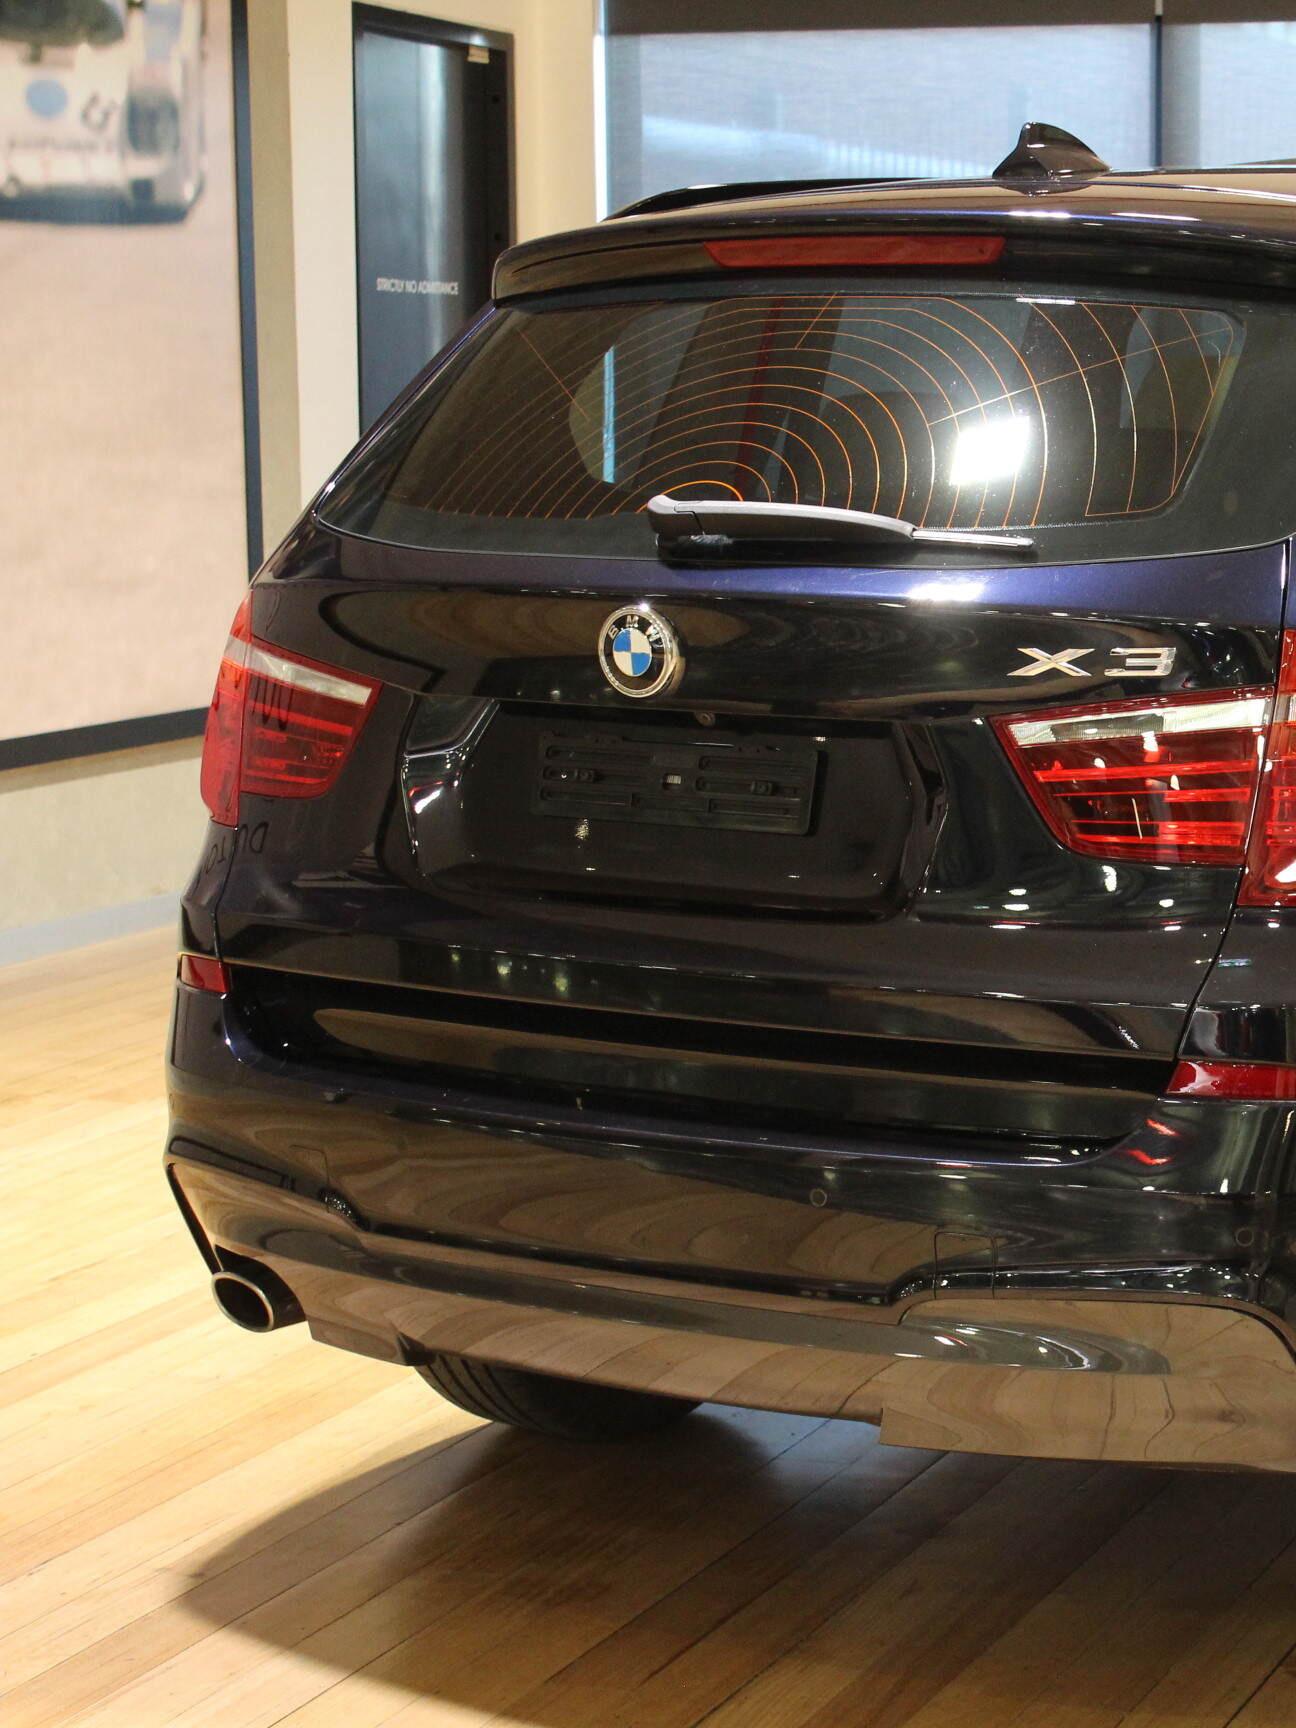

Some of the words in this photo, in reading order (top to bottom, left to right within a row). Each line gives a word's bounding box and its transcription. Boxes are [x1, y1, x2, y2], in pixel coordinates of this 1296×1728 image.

[376, 278, 405, 292] STRICTLY
[405, 280, 418, 294] NO
[1006, 647, 1177, 677] X3
